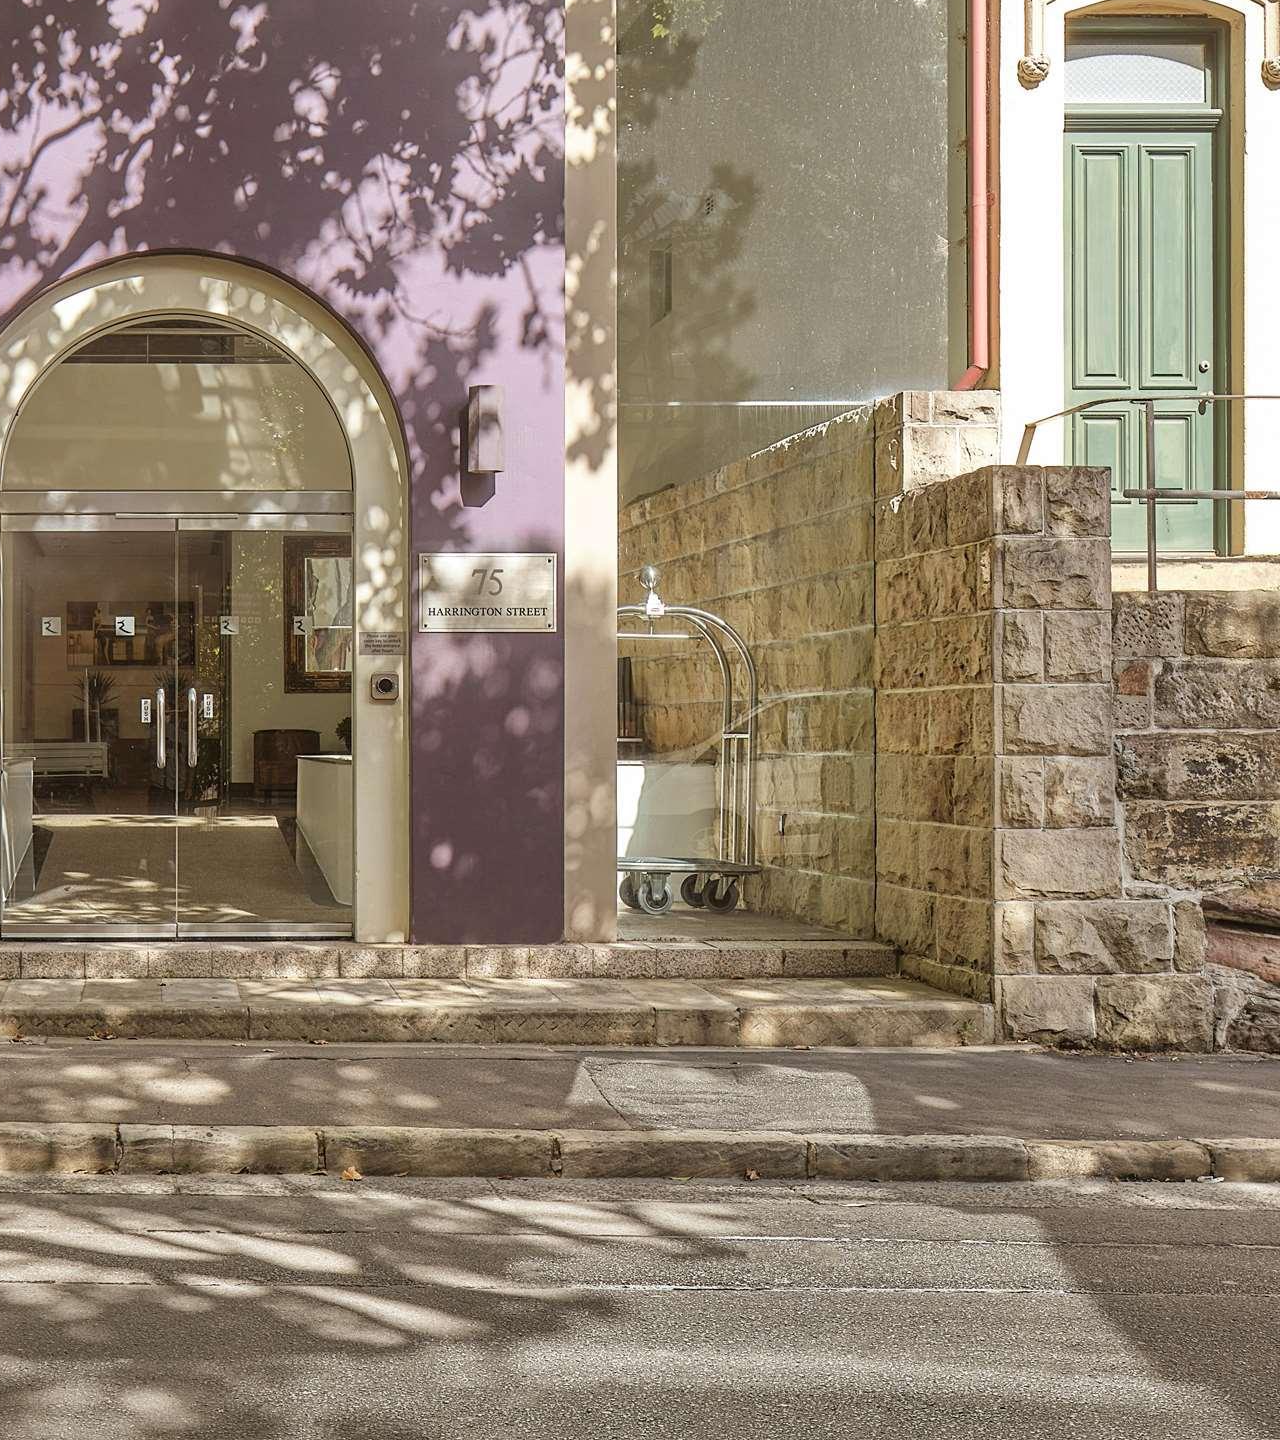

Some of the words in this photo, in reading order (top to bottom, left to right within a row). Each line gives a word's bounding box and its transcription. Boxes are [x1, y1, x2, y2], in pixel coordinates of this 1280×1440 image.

[472, 569, 504, 596] 75
[428, 607, 502, 617] HARRINGTON
[506, 607, 547, 617] STREET
